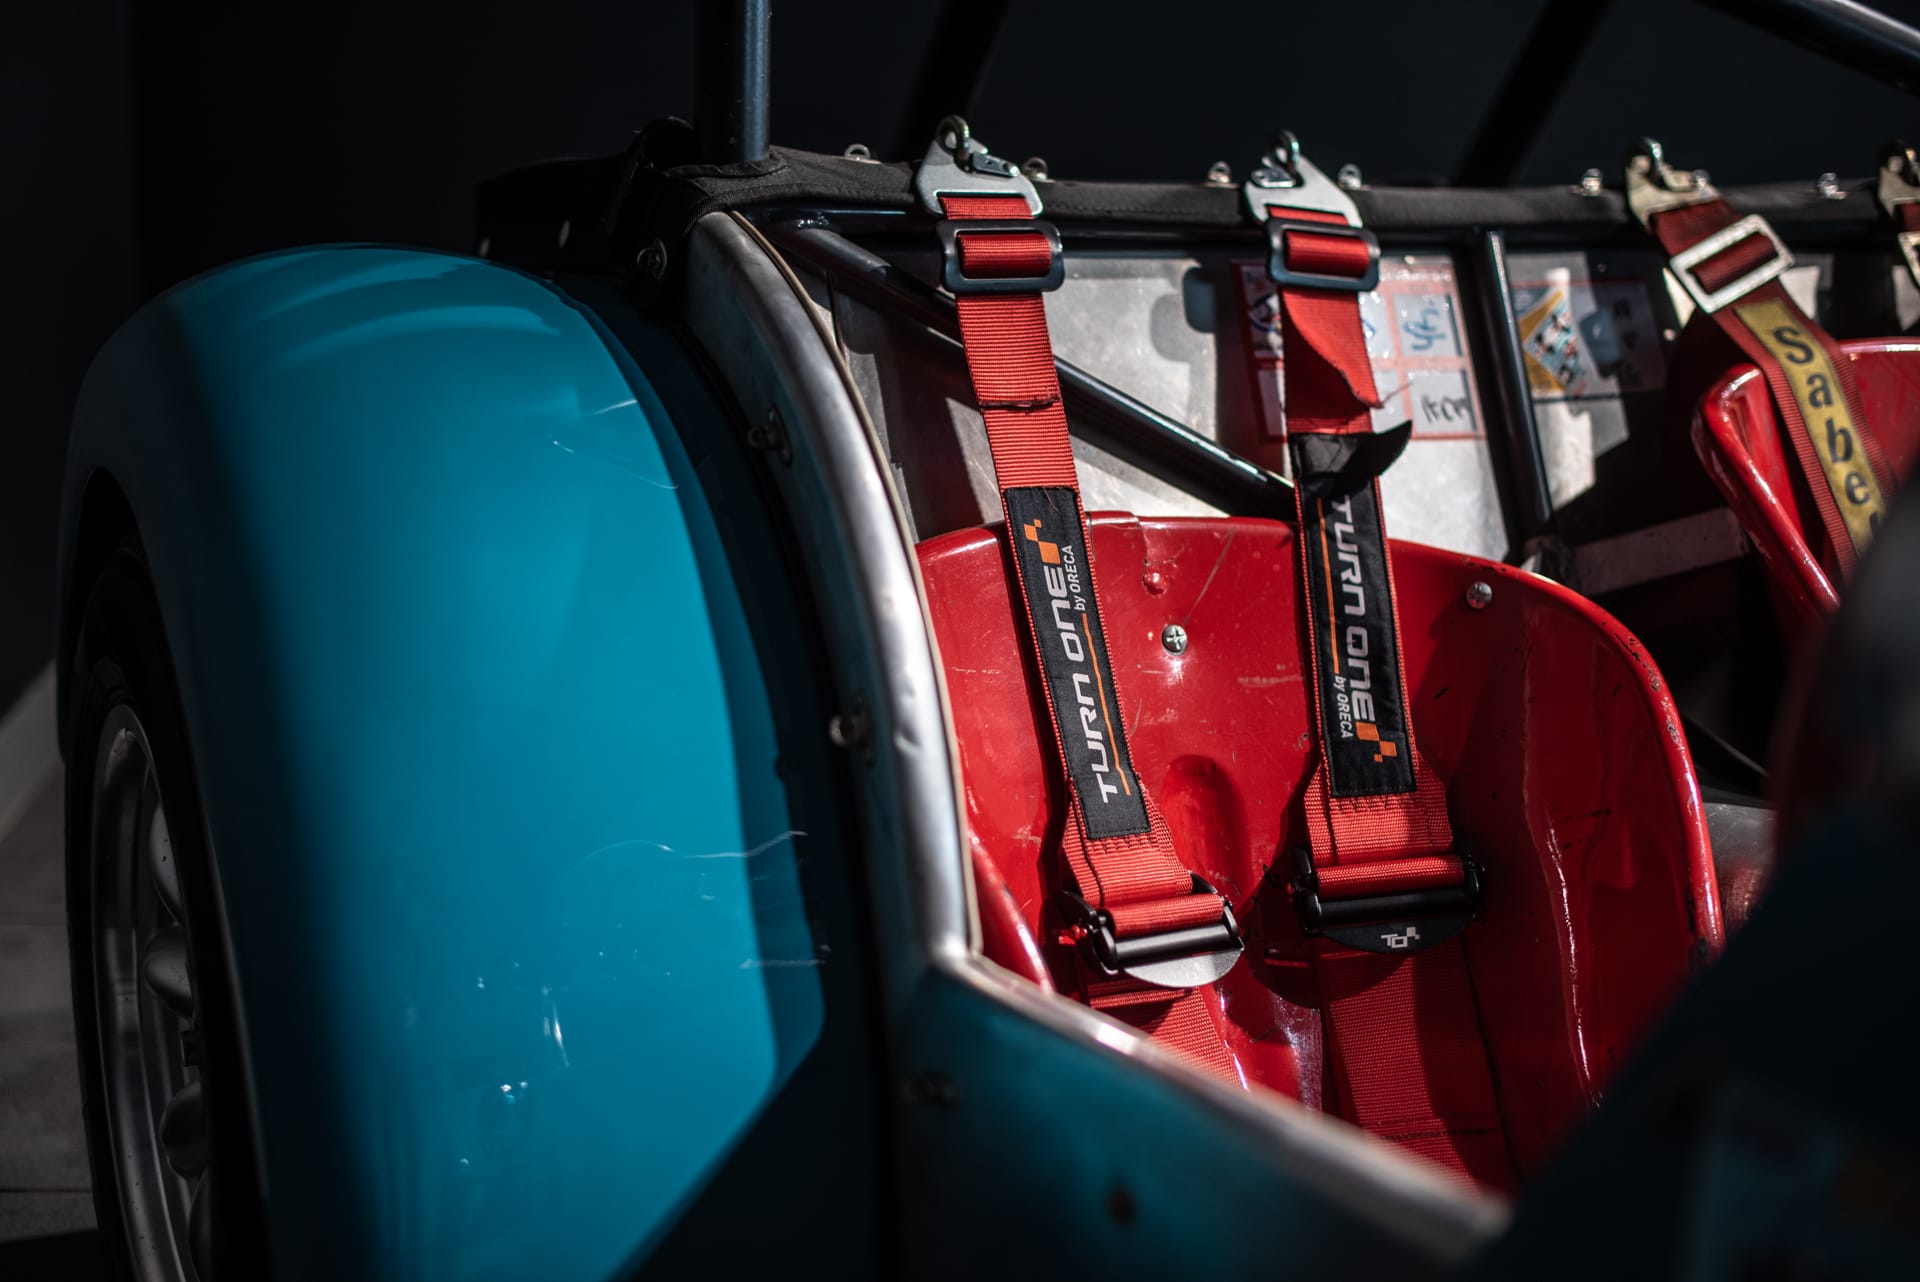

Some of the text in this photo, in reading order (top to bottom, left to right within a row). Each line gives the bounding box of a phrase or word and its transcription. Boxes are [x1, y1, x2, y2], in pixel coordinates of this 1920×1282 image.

[1061, 545, 1086, 611] by ORECA
[1332, 494, 1376, 722] TURN ONE
[1044, 565, 1118, 803] TURN ONE
[1335, 676, 1354, 739] by ORECA
